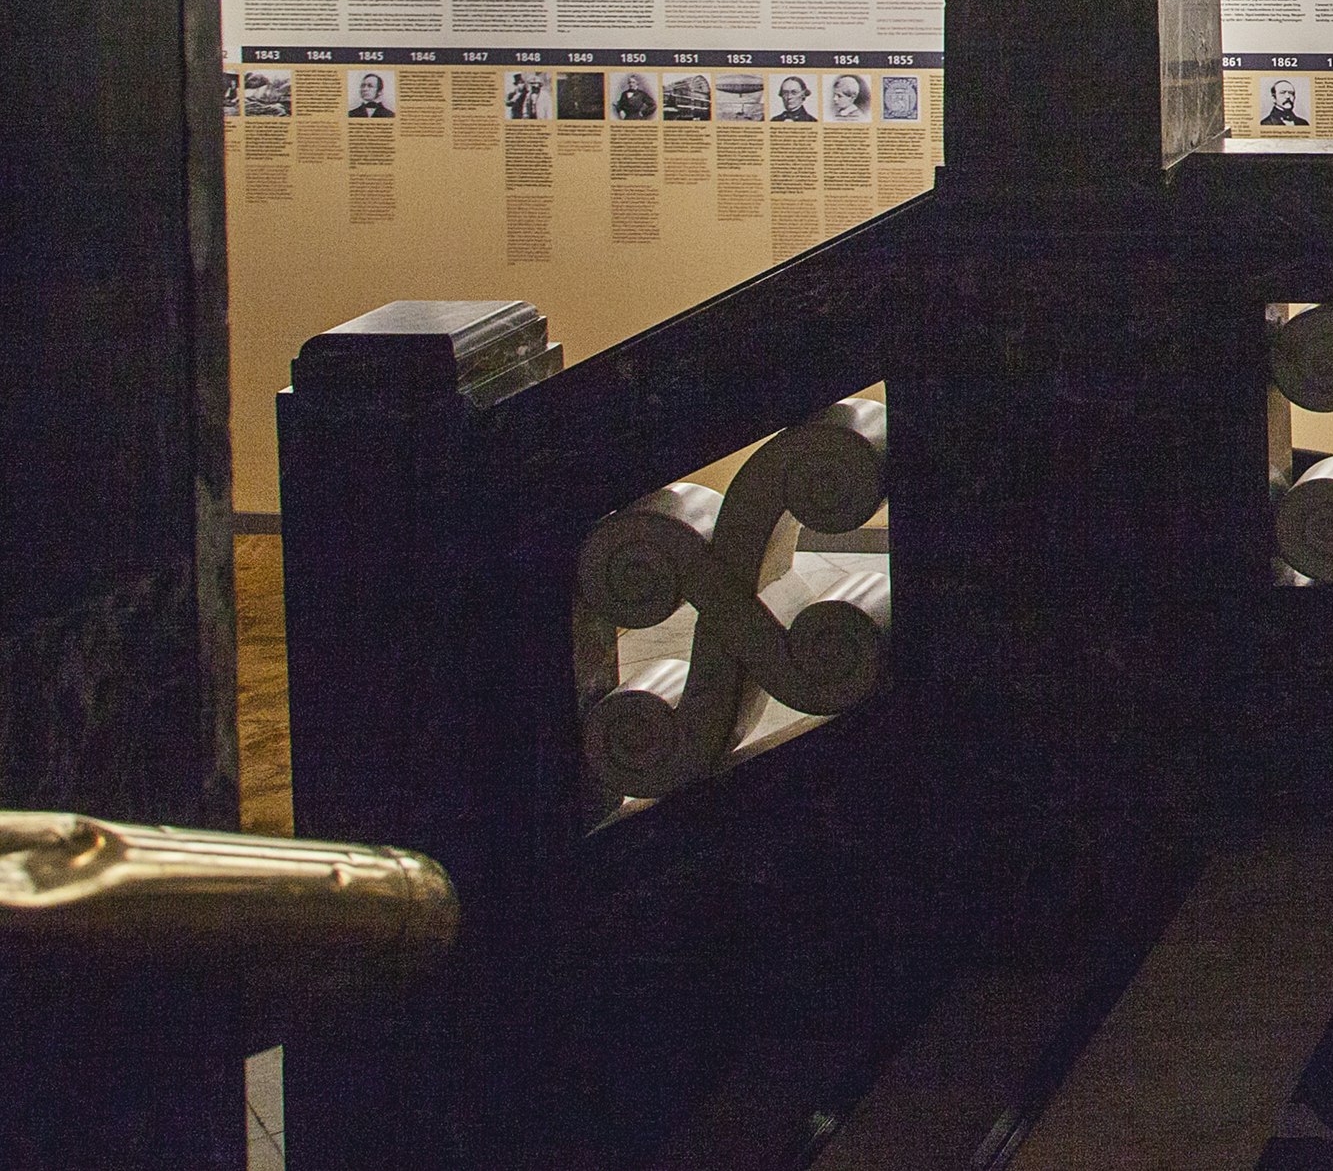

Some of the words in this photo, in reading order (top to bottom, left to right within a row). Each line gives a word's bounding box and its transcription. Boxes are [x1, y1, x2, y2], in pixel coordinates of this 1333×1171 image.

[255, 50, 280, 60] 1843
[307, 51, 332, 60] 1844
[359, 51, 384, 61] 1845
[411, 52, 436, 61] 1846
[463, 52, 488, 61] 1847
[516, 52, 541, 62] 1848
[568, 53, 594, 63] 1849
[621, 53, 647, 63] 1850
[674, 53, 699, 64] 1851
[727, 54, 752, 64] 1852
[780, 54, 806, 65] 1853
[834, 55, 860, 65] 1854
[887, 55, 914, 65] 1855
[1222, 56, 1241, 67] 861
[1271, 57, 1298, 68] 1862
